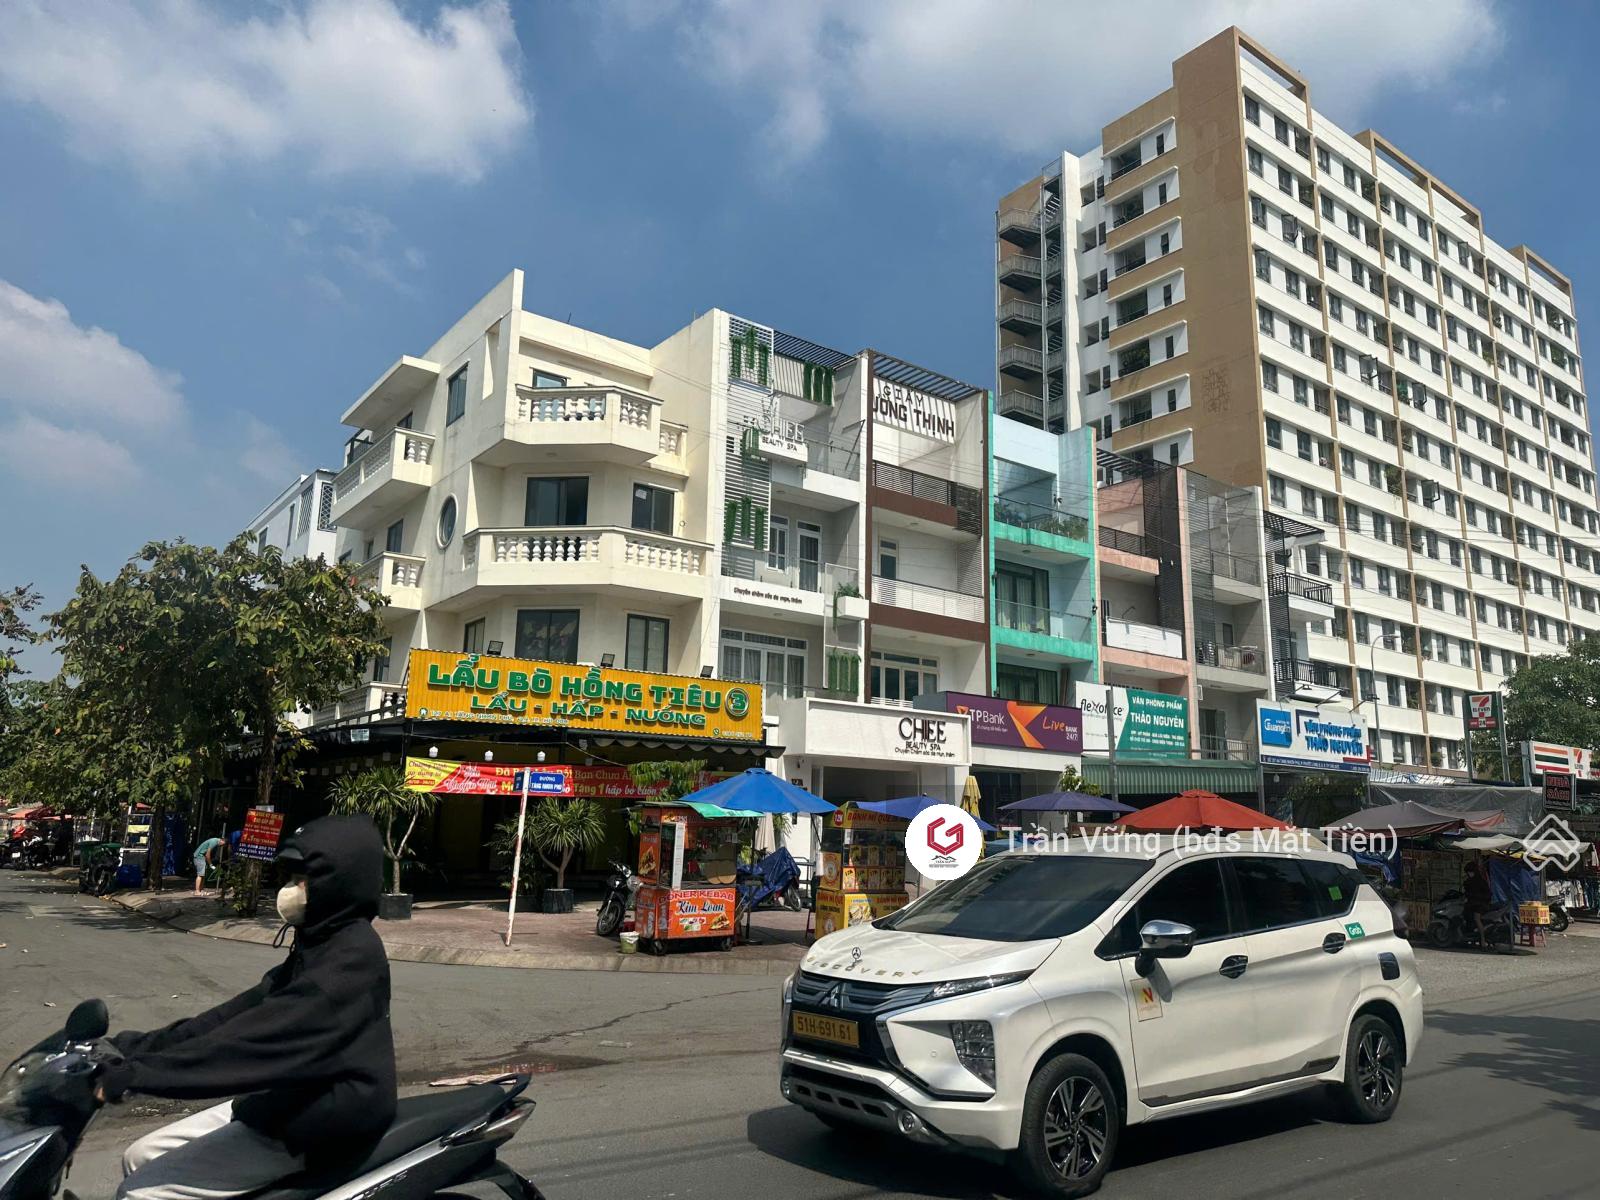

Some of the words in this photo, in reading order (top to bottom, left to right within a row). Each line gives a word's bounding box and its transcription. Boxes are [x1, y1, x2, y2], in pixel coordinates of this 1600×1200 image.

[914, 408, 954, 437] THỊNH
[762, 436, 783, 447] BEAUTY
[787, 443, 797, 451] SPA
[428, 653, 499, 689] LẨU
[561, 667, 643, 702] HỒNG
[650, 683, 722, 709] TIÊU
[731, 692, 747, 710] 3
[1132, 696, 1144, 705] VĂN
[1146, 698, 1165, 708] PHÒNG
[1166, 700, 1182, 710] PHẨM
[551, 699, 605, 717] HẤP
[626, 704, 706, 725] NƯỚNG
[970, 709, 1004, 725] TPBank
[1130, 711, 1151, 725] THẢO
[1153, 715, 1184, 728] NGUYÊN
[1042, 716, 1065, 731] Live
[906, 741, 927, 750] BEAUTY
[930, 743, 941, 751] SPA
[699, 890, 735, 901] KEBAB
[677, 900, 698, 914] Kim
[701, 901, 725, 912] Loan
[797, 1016, 852, 1041] 51H-691.61
